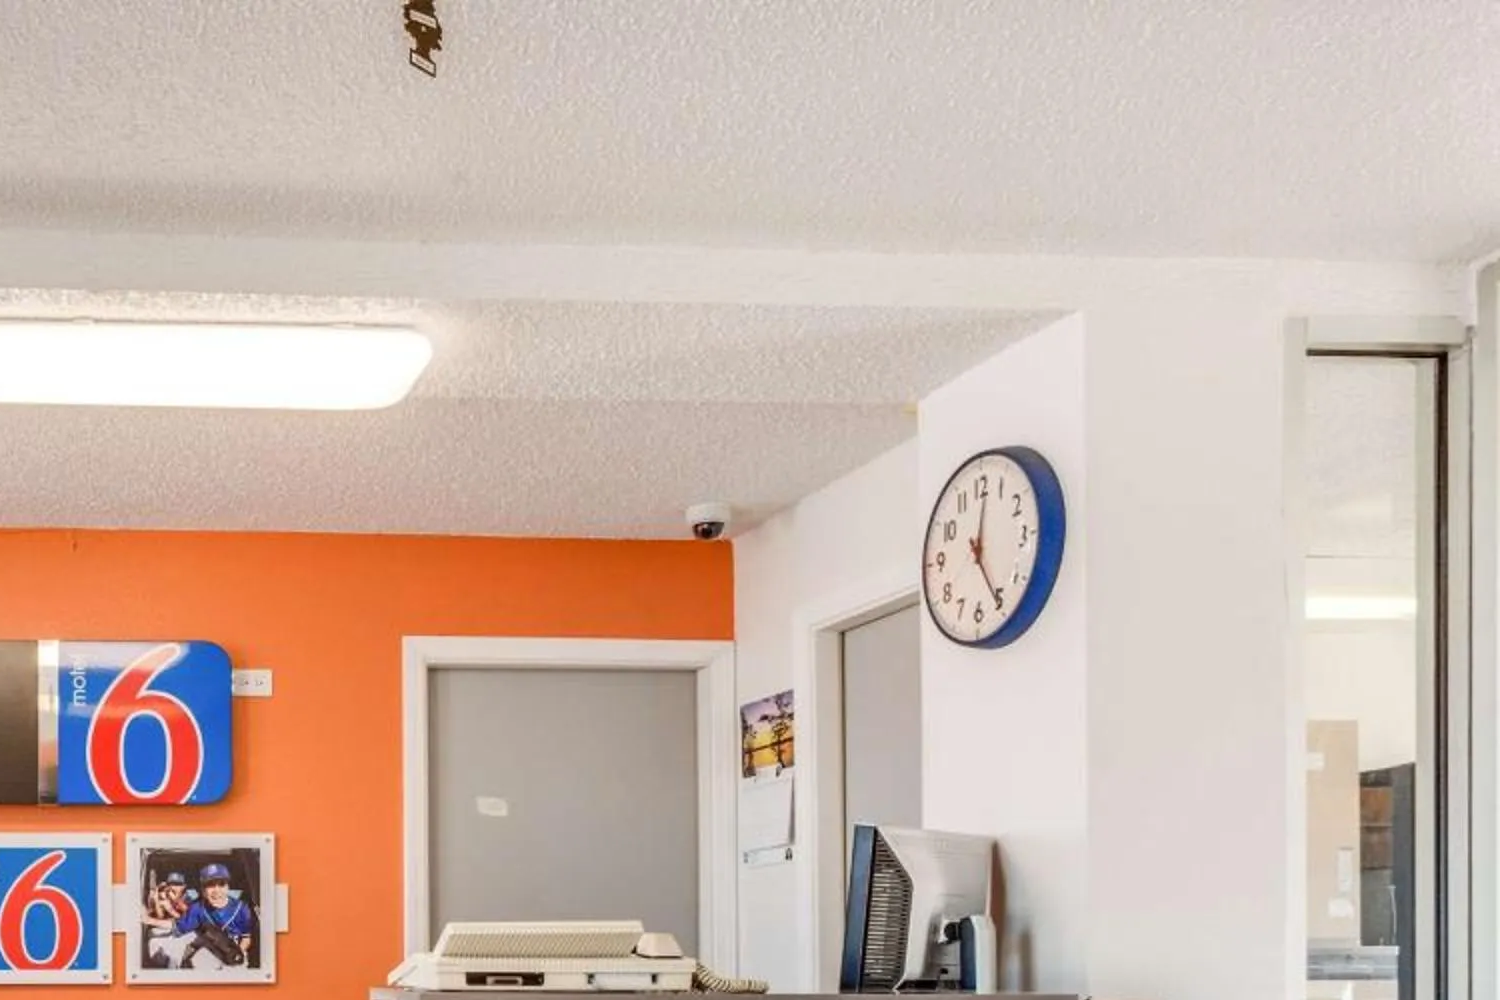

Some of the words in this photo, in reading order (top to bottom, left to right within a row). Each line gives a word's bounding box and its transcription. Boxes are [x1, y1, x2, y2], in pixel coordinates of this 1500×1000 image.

[974, 476, 989, 500] 12
[999, 477, 1004, 499] 1
[957, 492, 968, 513] 11
[1011, 494, 1022, 517] 2
[943, 520, 957, 542] 10
[1018, 525, 1028, 547] 3
[936, 551, 946, 572] 9
[943, 582, 953, 604] 8
[994, 587, 1004, 610] 5
[956, 598, 965, 620] 7
[973, 601, 985, 623] 6
[86, 643, 204, 804] 6
